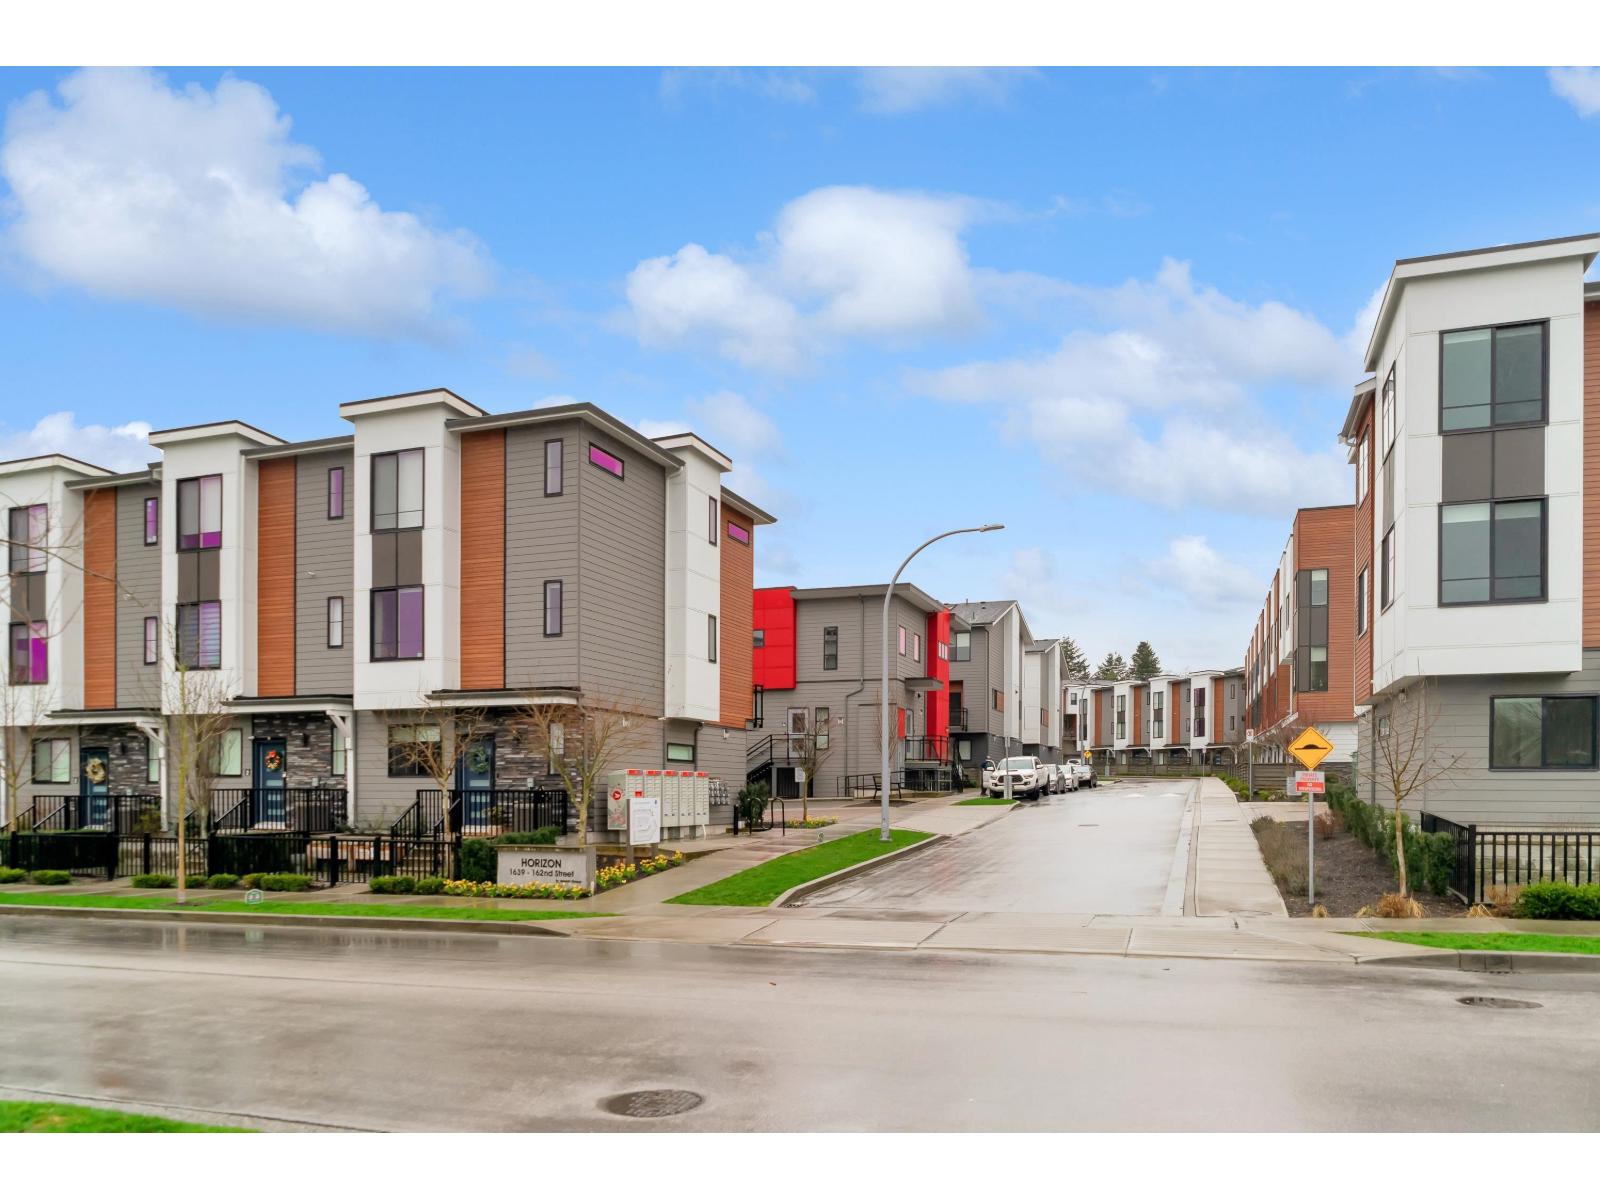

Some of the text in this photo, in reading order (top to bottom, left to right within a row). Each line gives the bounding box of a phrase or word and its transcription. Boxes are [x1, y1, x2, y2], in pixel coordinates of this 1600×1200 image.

[521, 858, 562, 868] HORIZON
[532, 869, 553, 877] 162nd
[555, 870, 574, 878] Street
